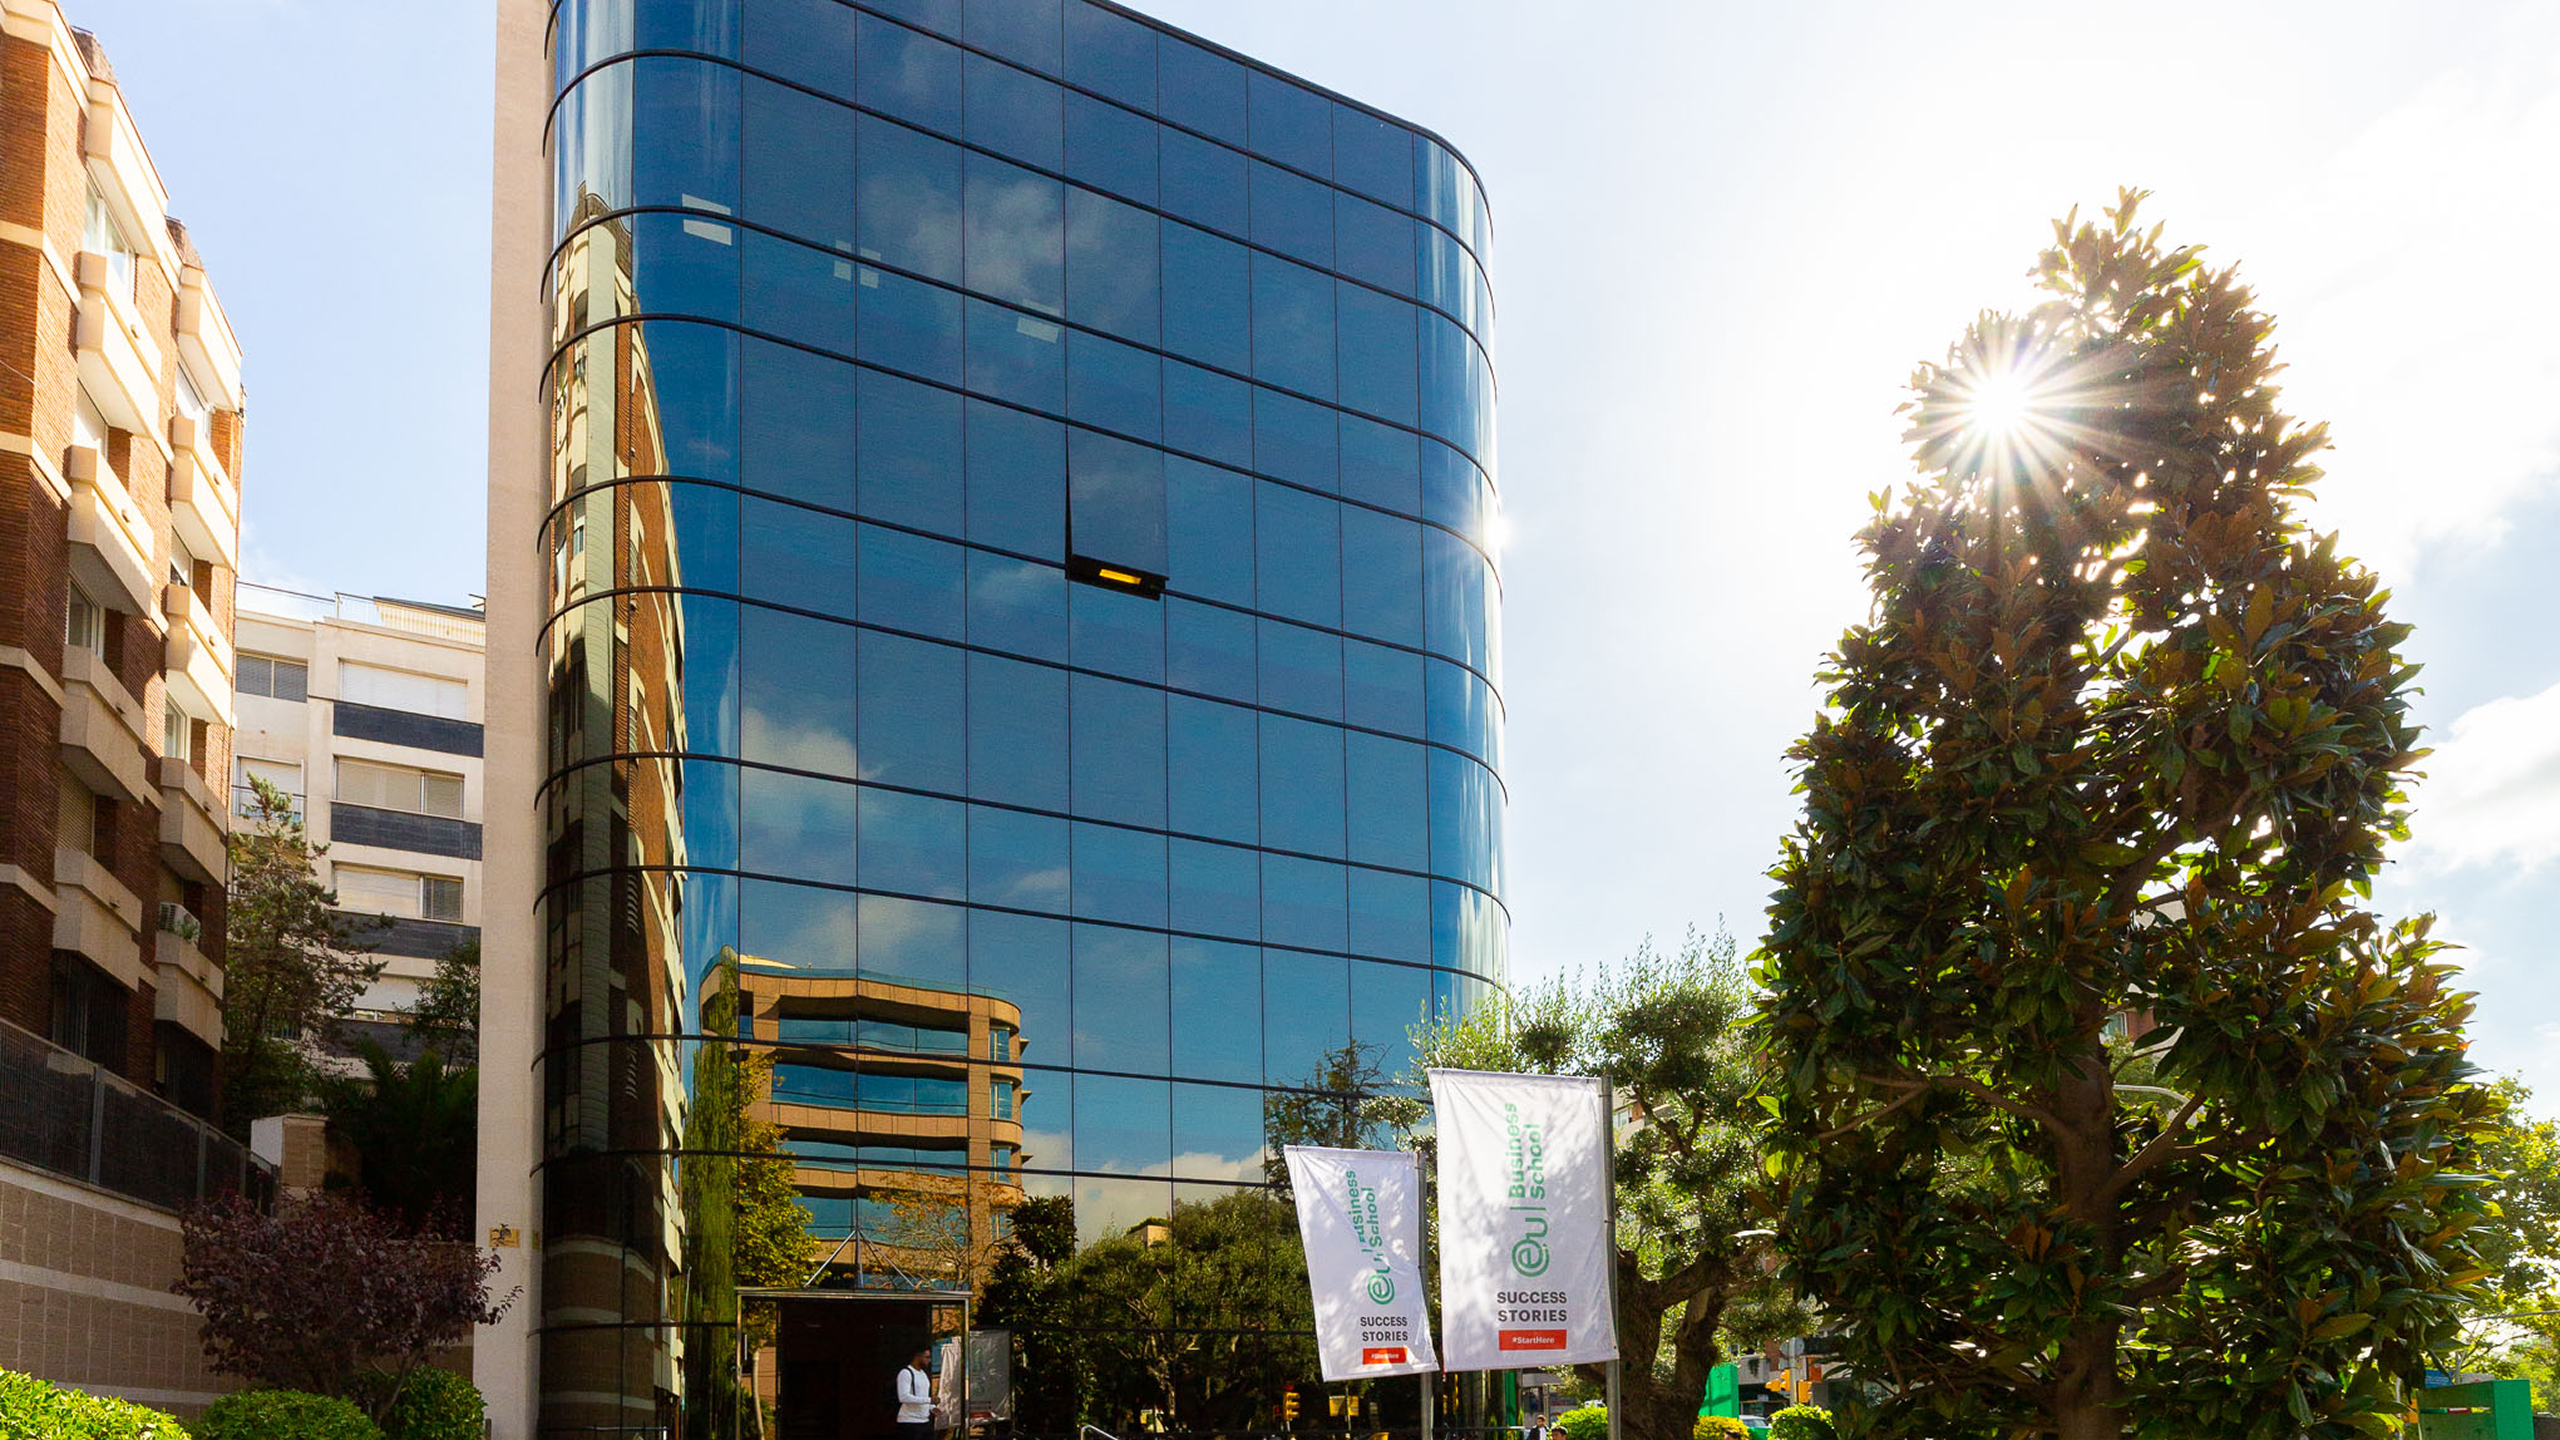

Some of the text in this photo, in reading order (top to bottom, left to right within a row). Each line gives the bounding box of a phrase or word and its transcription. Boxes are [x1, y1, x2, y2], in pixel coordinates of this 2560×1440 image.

[1505, 1103, 1526, 1199] Business
[1523, 1123, 1546, 1201] School
[1361, 1187, 1382, 1248] School
[1497, 1291, 1567, 1304] SUCCESS
[1360, 1316, 1408, 1327] SUCCESS
[1498, 1309, 1567, 1322] STORIES
[1362, 1331, 1408, 1342] STORIES
[1512, 1336, 1556, 1344] #StartHere
